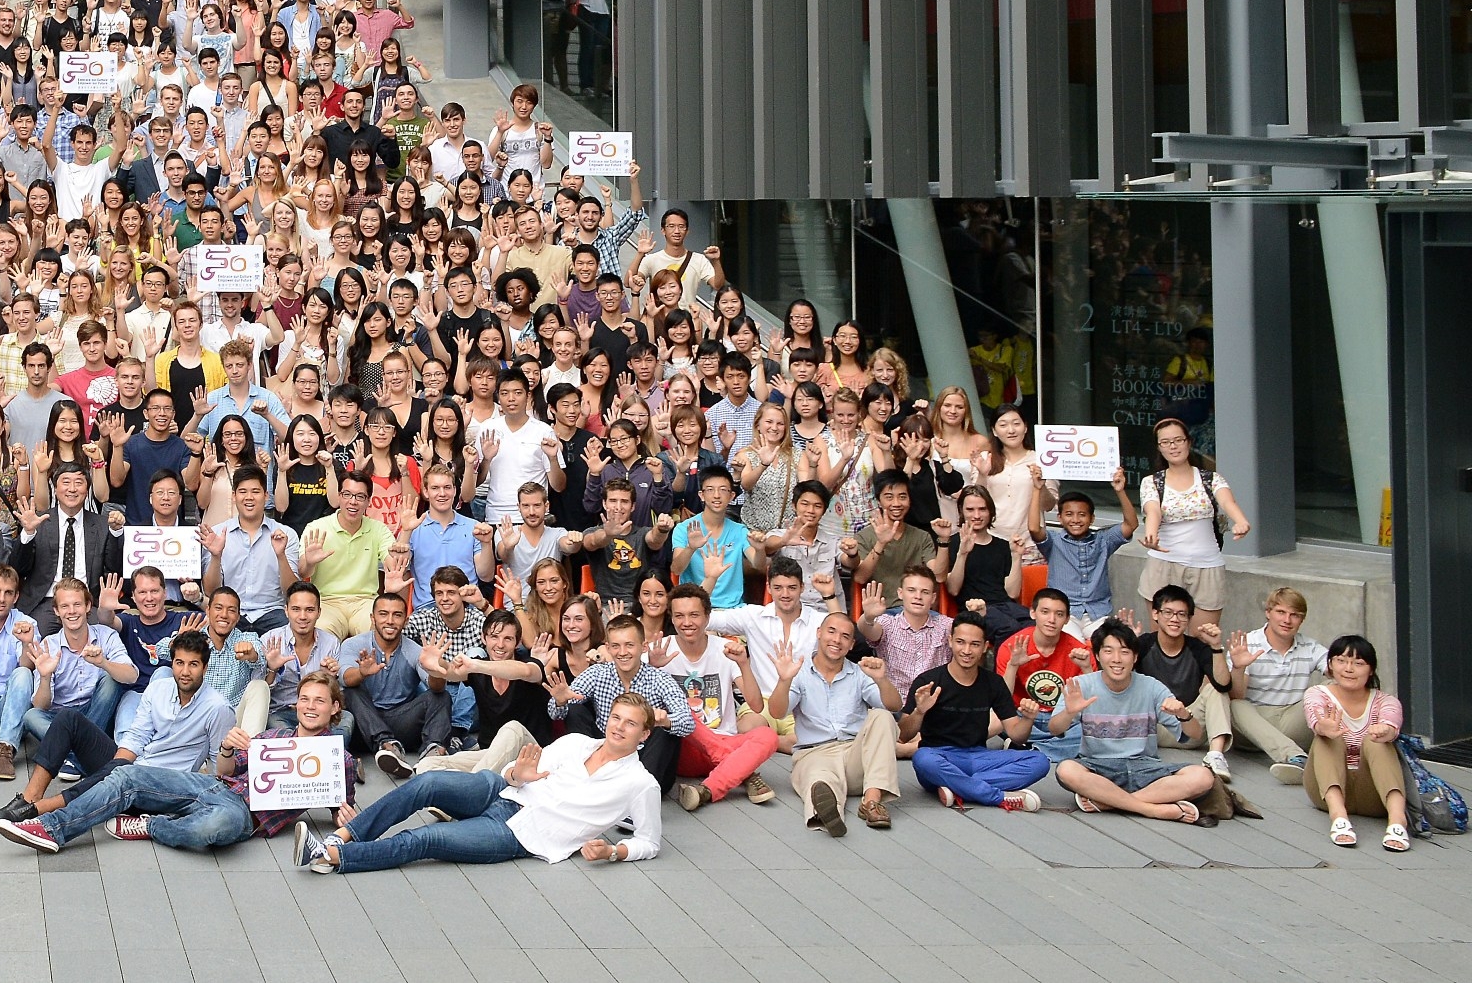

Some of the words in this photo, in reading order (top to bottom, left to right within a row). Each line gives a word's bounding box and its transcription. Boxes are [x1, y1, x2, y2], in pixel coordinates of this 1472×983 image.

[396, 124, 419, 132] FITCH
[1079, 303, 1095, 332] 2
[1112, 320, 1140, 334] LT4
[1155, 322, 1183, 337] LT9
[1082, 362, 1093, 391] 1
[1112, 379, 1206, 399] BOOKSTORE
[382, 511, 397, 524] IT
